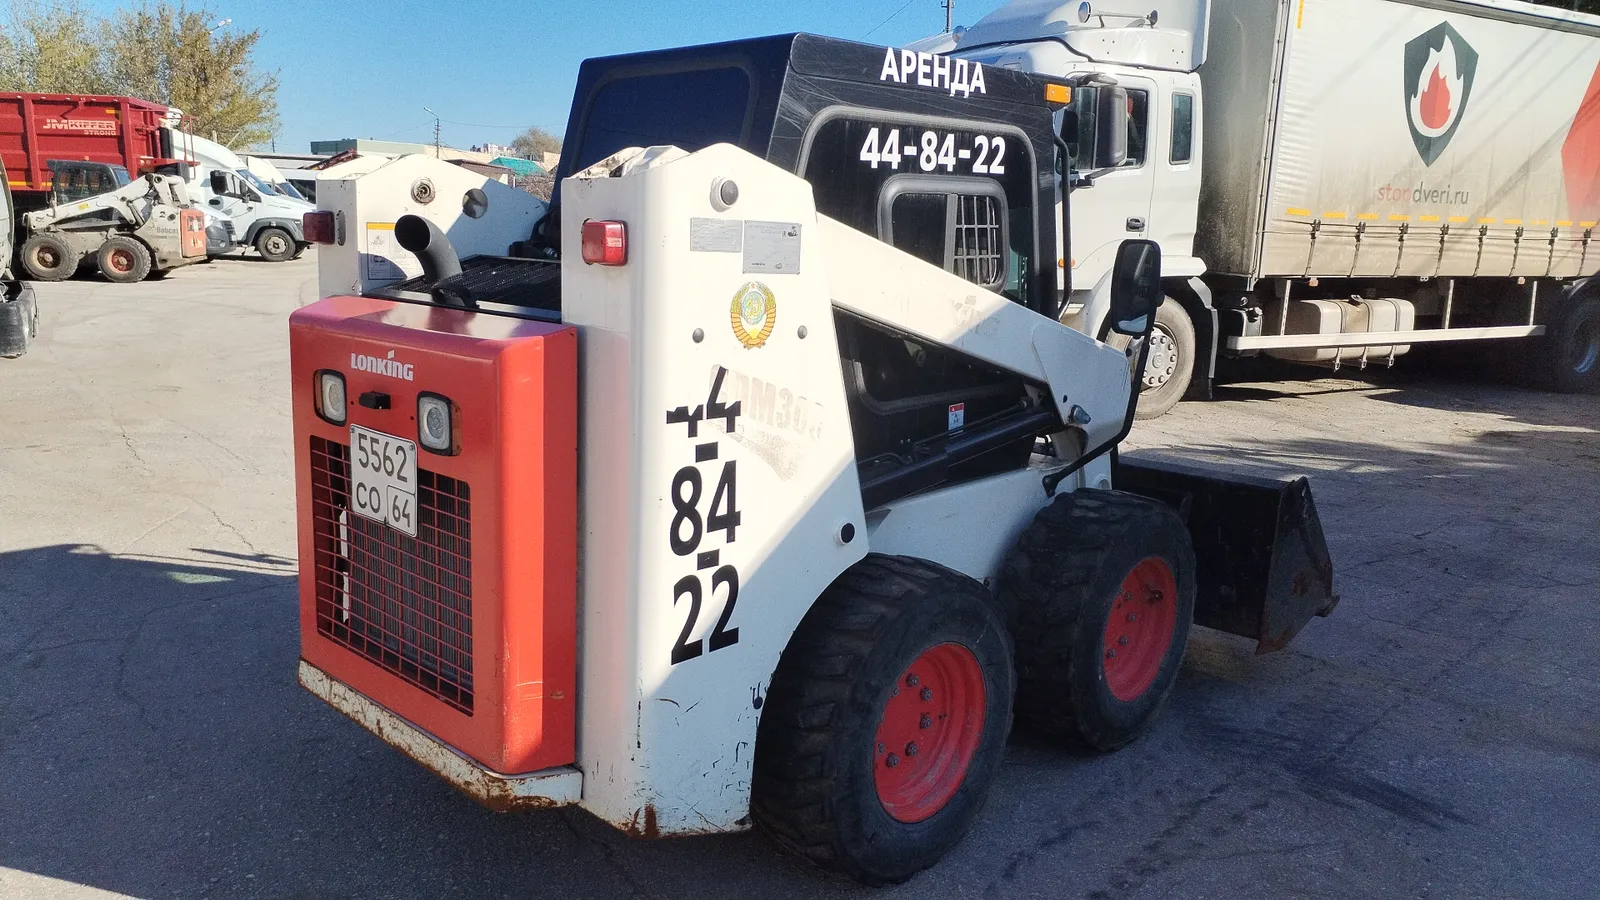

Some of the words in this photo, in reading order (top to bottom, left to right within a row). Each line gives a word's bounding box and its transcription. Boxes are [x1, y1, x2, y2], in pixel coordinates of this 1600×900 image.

[879, 47, 988, 98] АРЕНДА
[859, 127, 1006, 175] 44-84-22
[358, 432, 409, 483] 5562
[391, 494, 411, 528] 64
